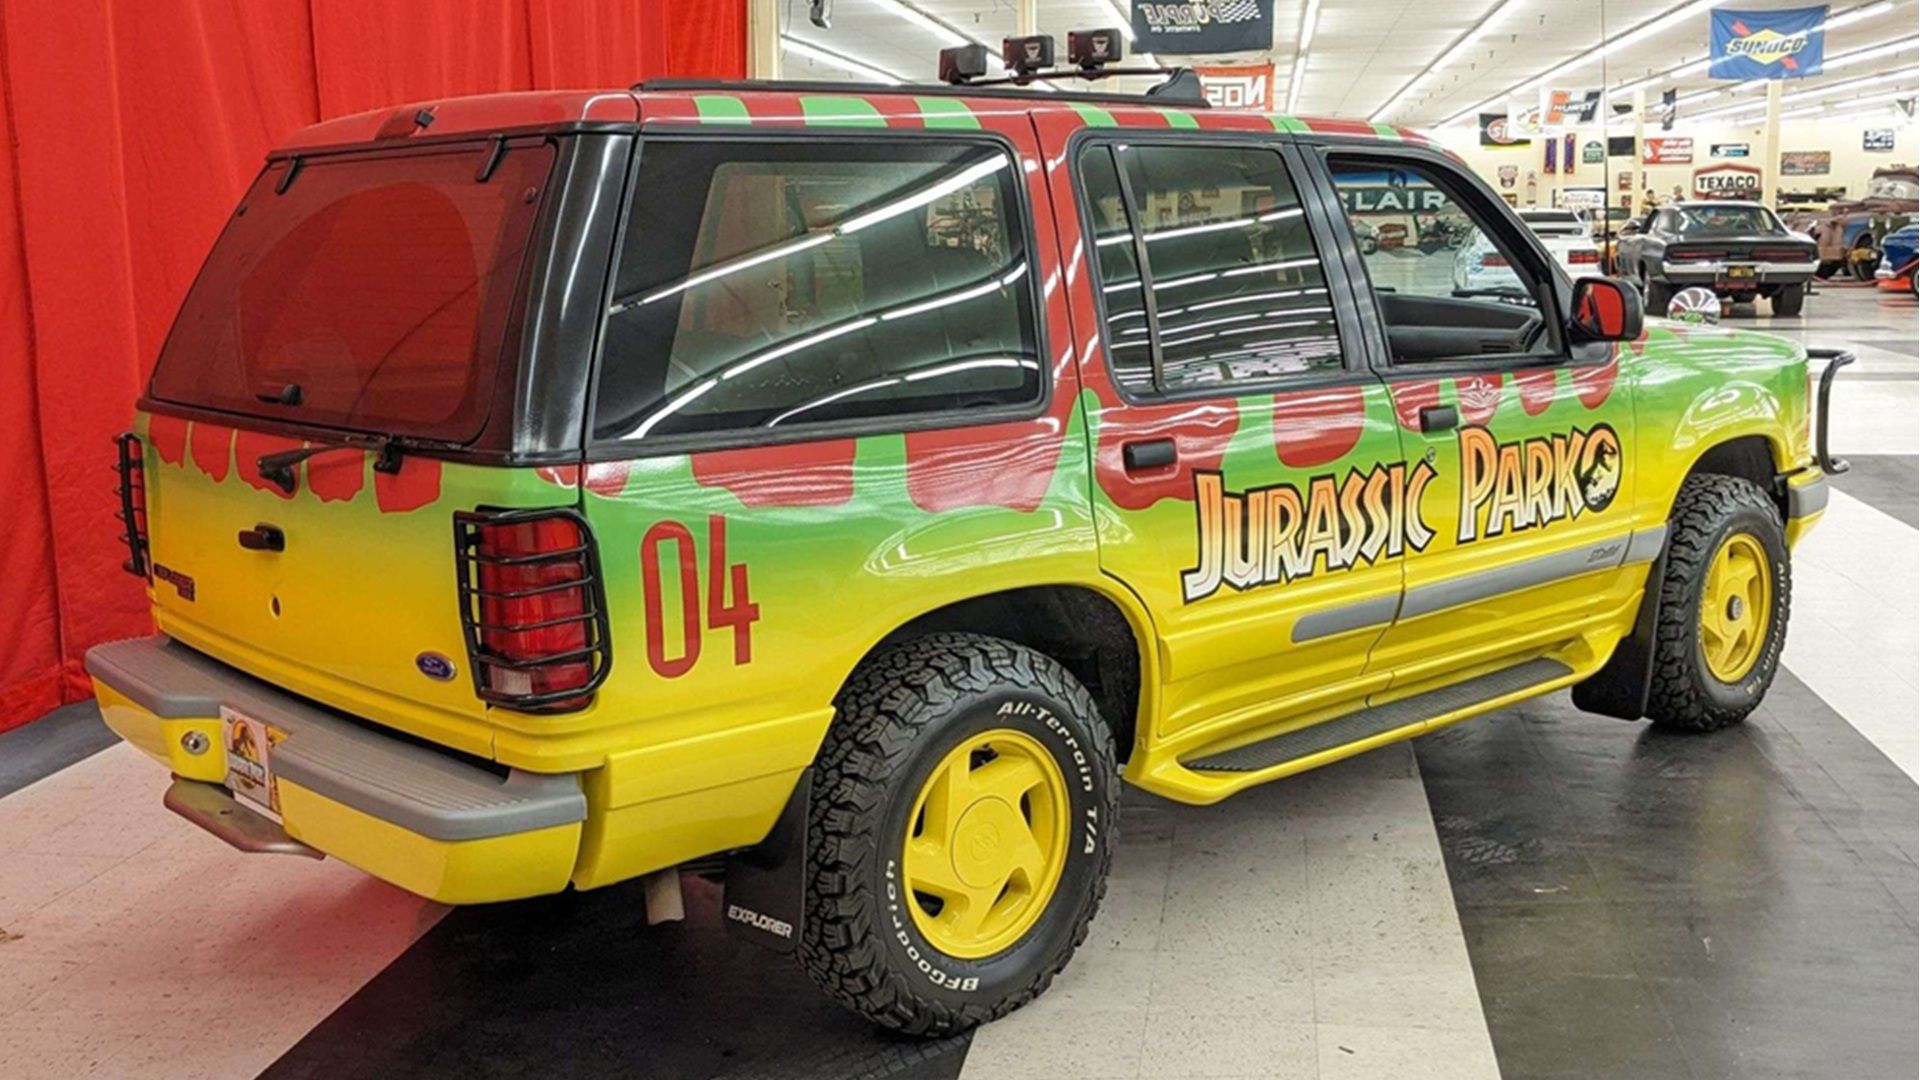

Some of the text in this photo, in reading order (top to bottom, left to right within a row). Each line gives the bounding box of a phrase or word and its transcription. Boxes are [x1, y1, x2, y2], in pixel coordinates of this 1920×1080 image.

[1730, 37, 1806, 54] SUNOCO
[1698, 175, 1757, 190] TEXACO
[1181, 424, 1587, 605] JURASSIC PARK
[640, 513, 760, 679] 04
[1084, 806, 1098, 855] T/A
[728, 904, 793, 939] EXPLORER
[885, 860, 979, 991] BFGoodrich
